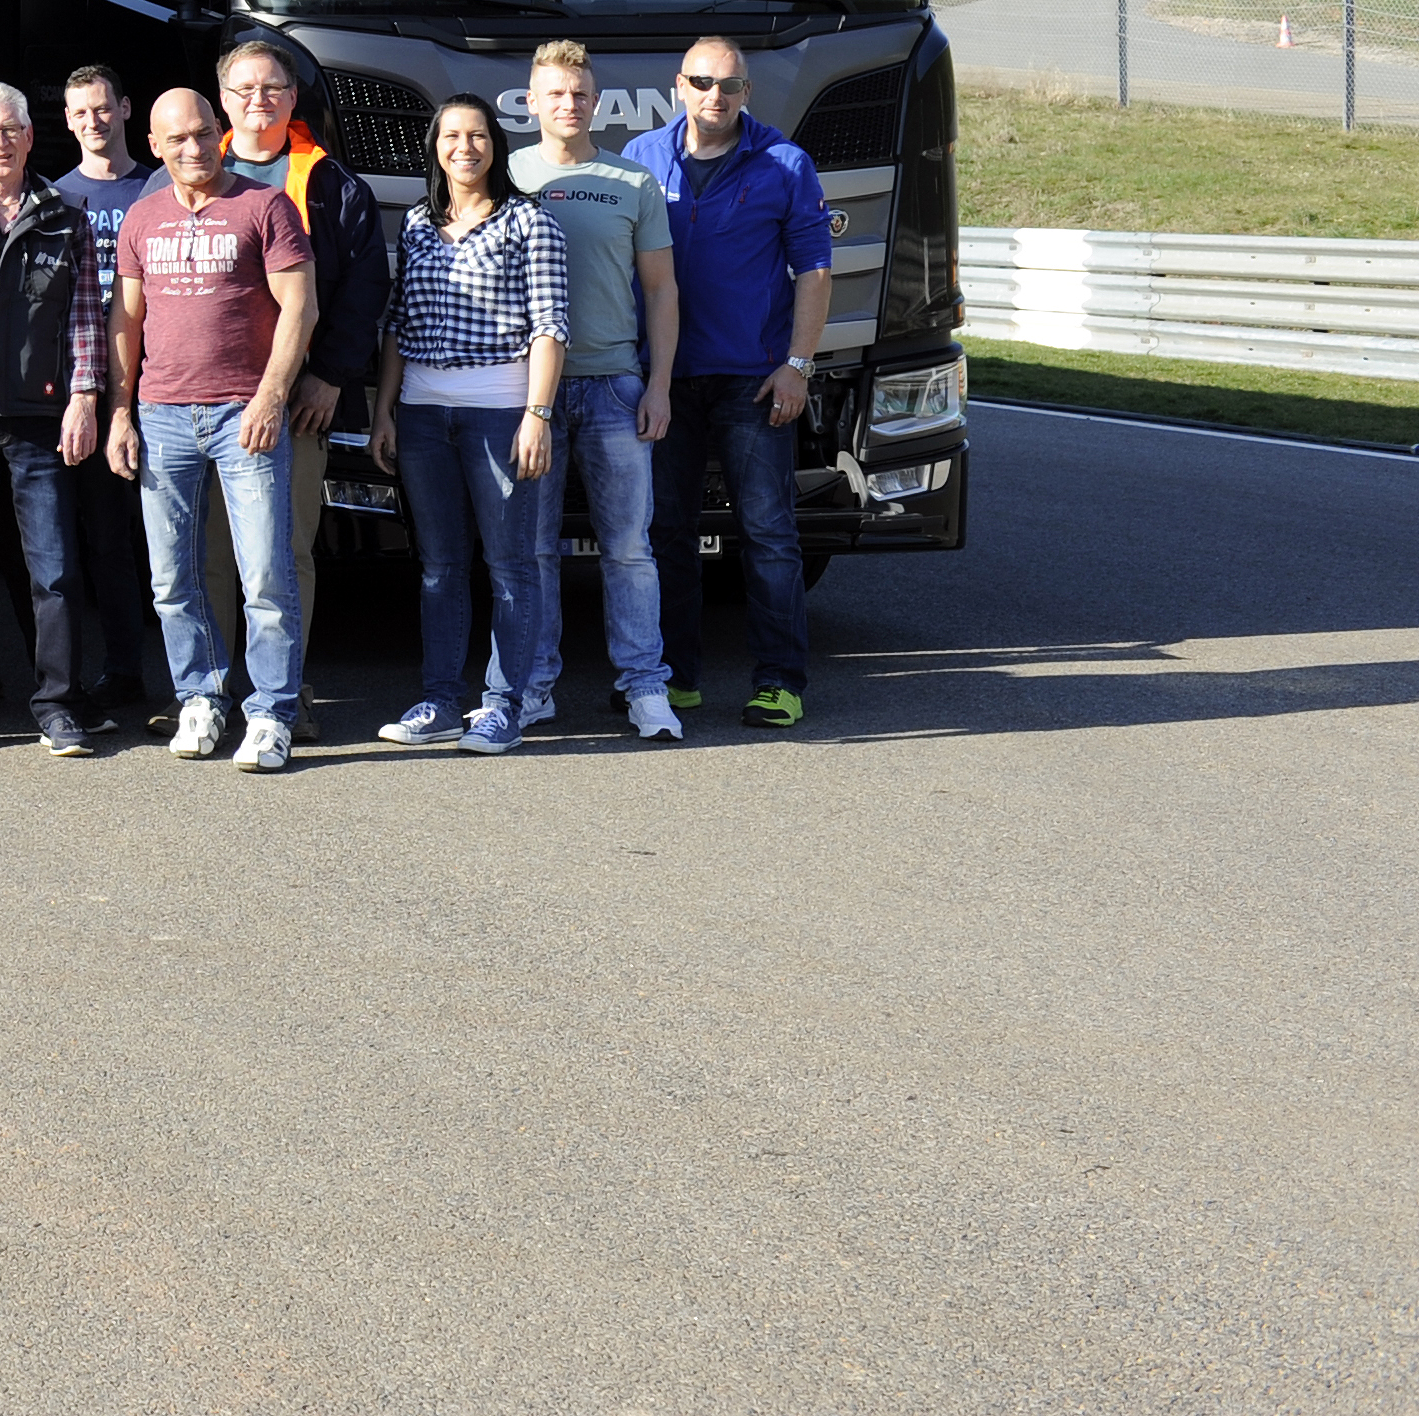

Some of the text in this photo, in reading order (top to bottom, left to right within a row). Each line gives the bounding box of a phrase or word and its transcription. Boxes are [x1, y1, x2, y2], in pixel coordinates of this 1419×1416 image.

[496, 87, 751, 134] SAN
[566, 190, 619, 206] JONES
[87, 208, 124, 233] PAP
[146, 233, 238, 263] TOM TAILOR
[195, 260, 235, 274] BRAND
